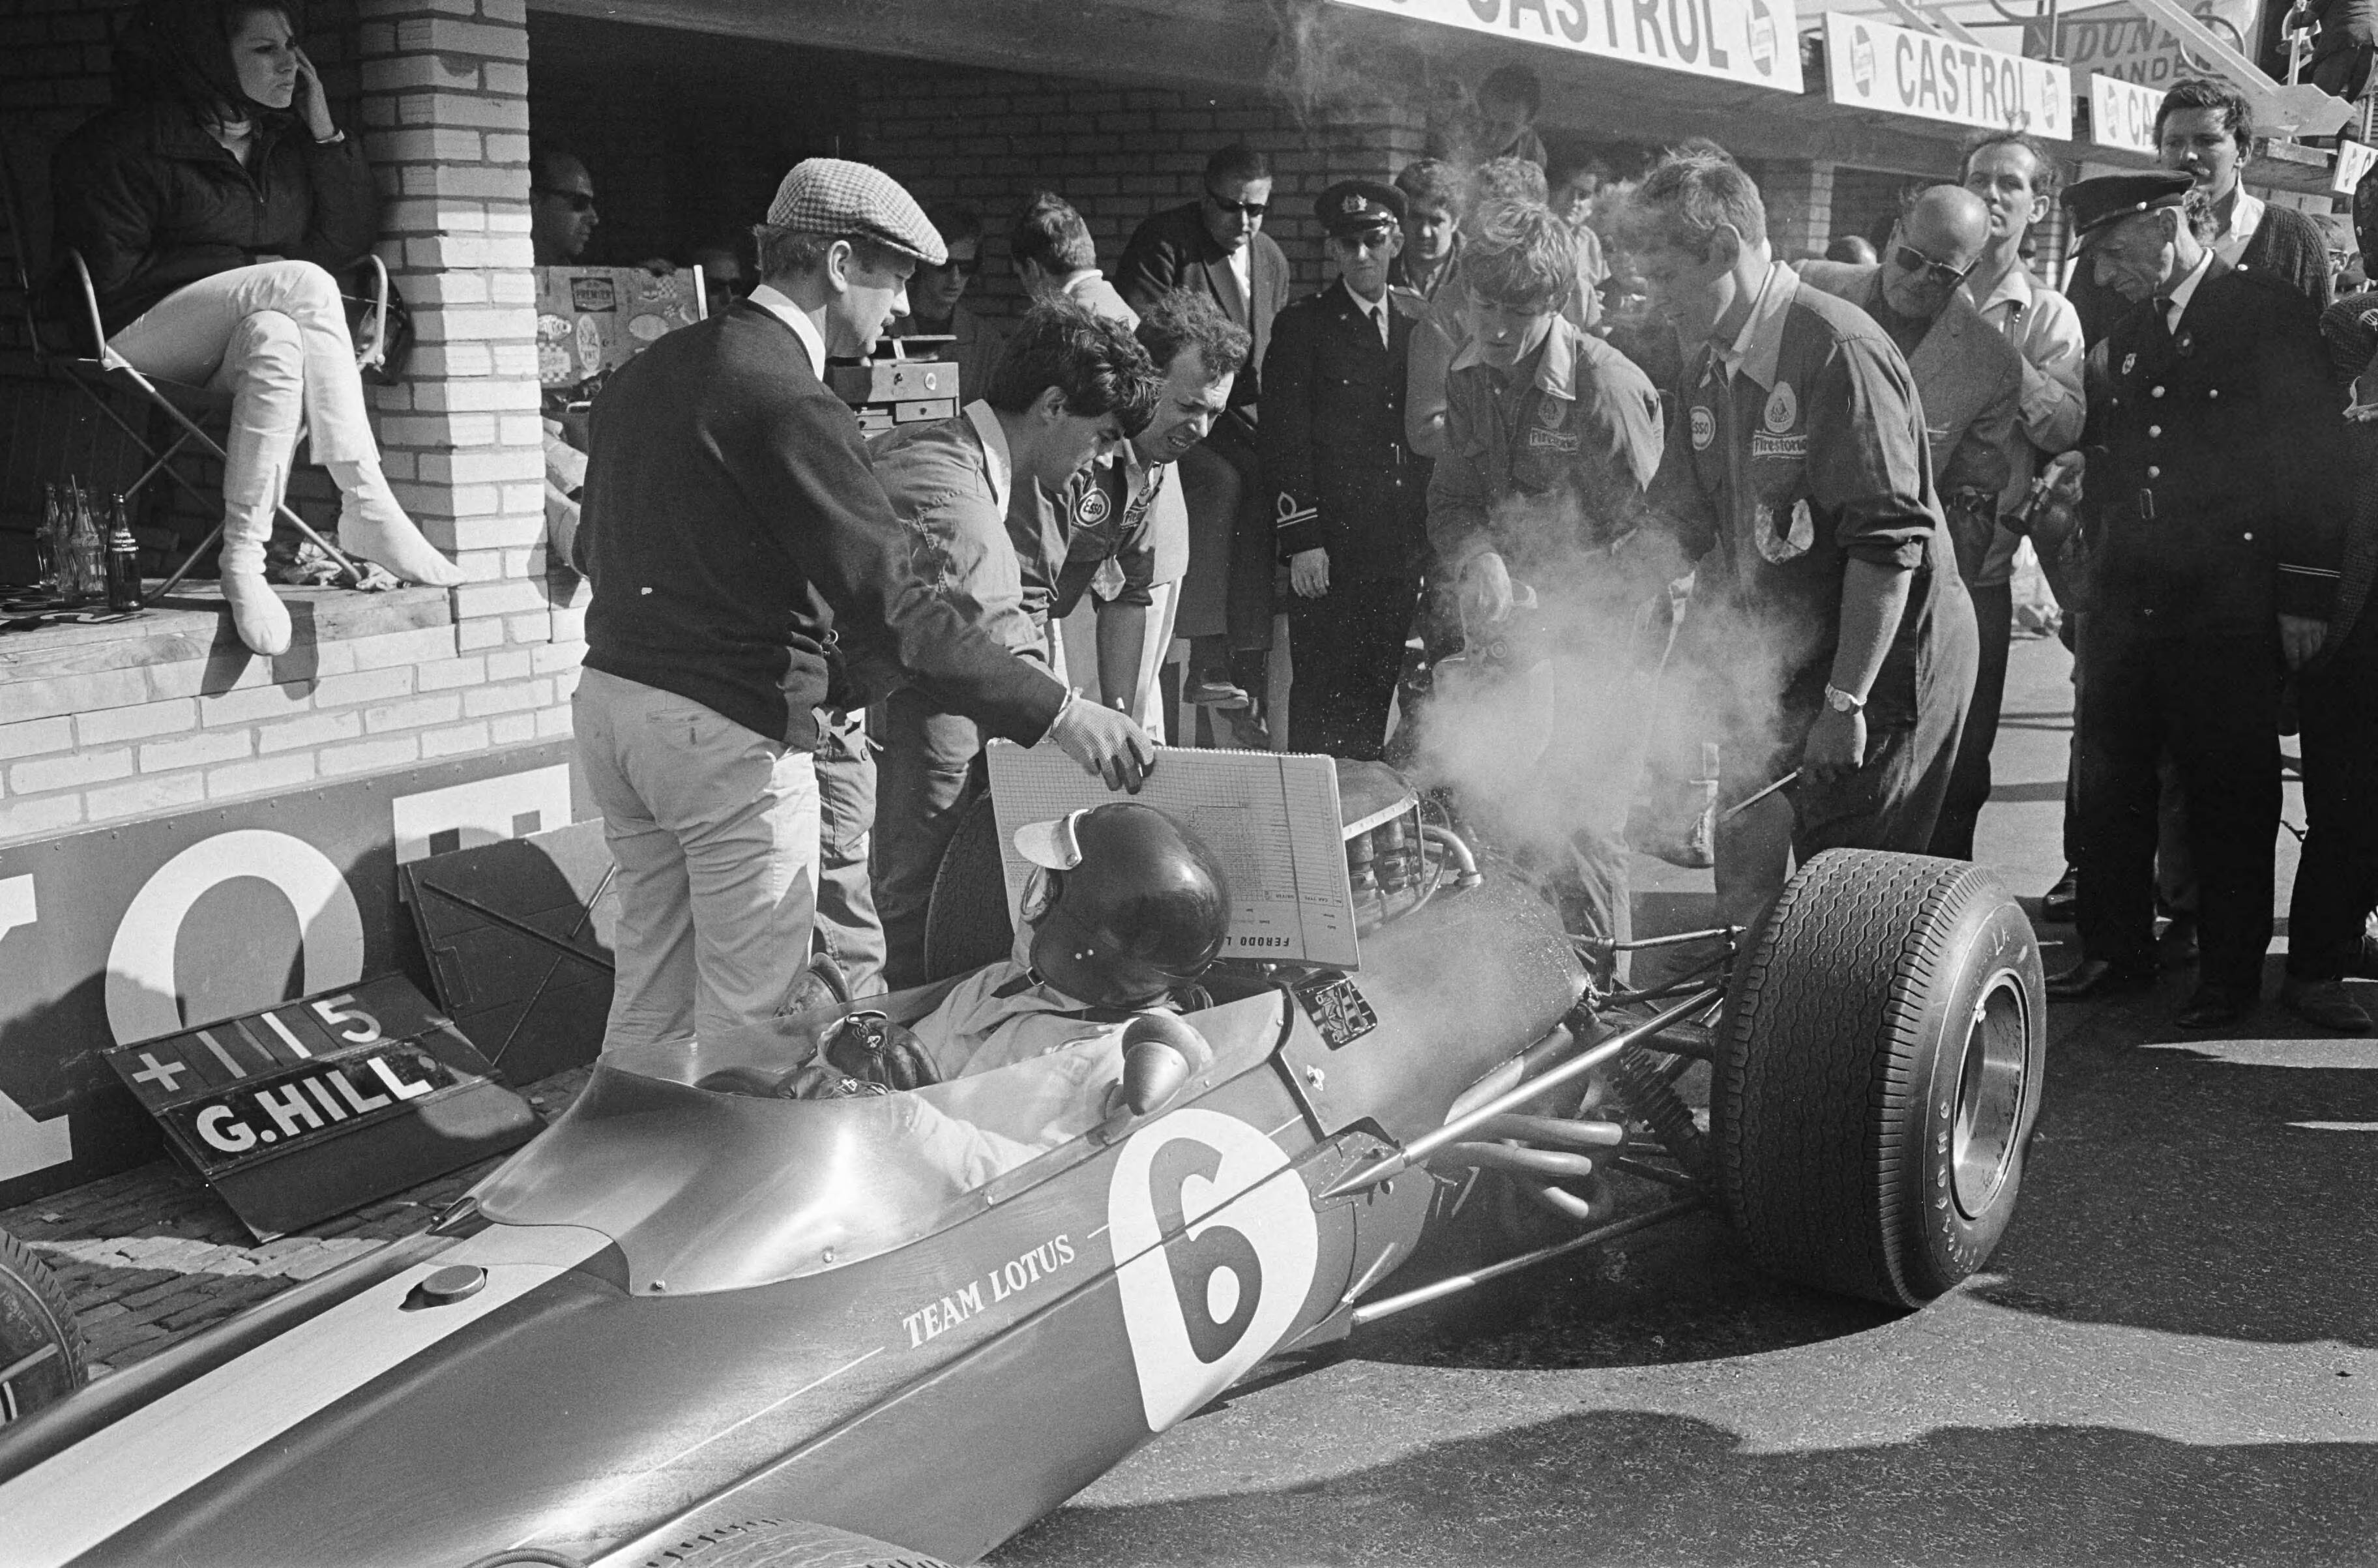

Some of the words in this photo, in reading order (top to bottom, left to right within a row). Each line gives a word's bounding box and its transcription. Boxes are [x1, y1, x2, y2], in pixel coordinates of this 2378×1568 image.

[1465, 0, 1729, 69] STROL
[2091, 52, 2214, 84] ANDE
[1896, 33, 2031, 127] CASTROL
[1084, 499, 1103, 515] Esso
[1240, 936, 1290, 946] FERODO
[1149, 1137, 1263, 1365] 6
[902, 1281, 984, 1349] TEAM
[988, 1234, 1075, 1297] LOTUS
